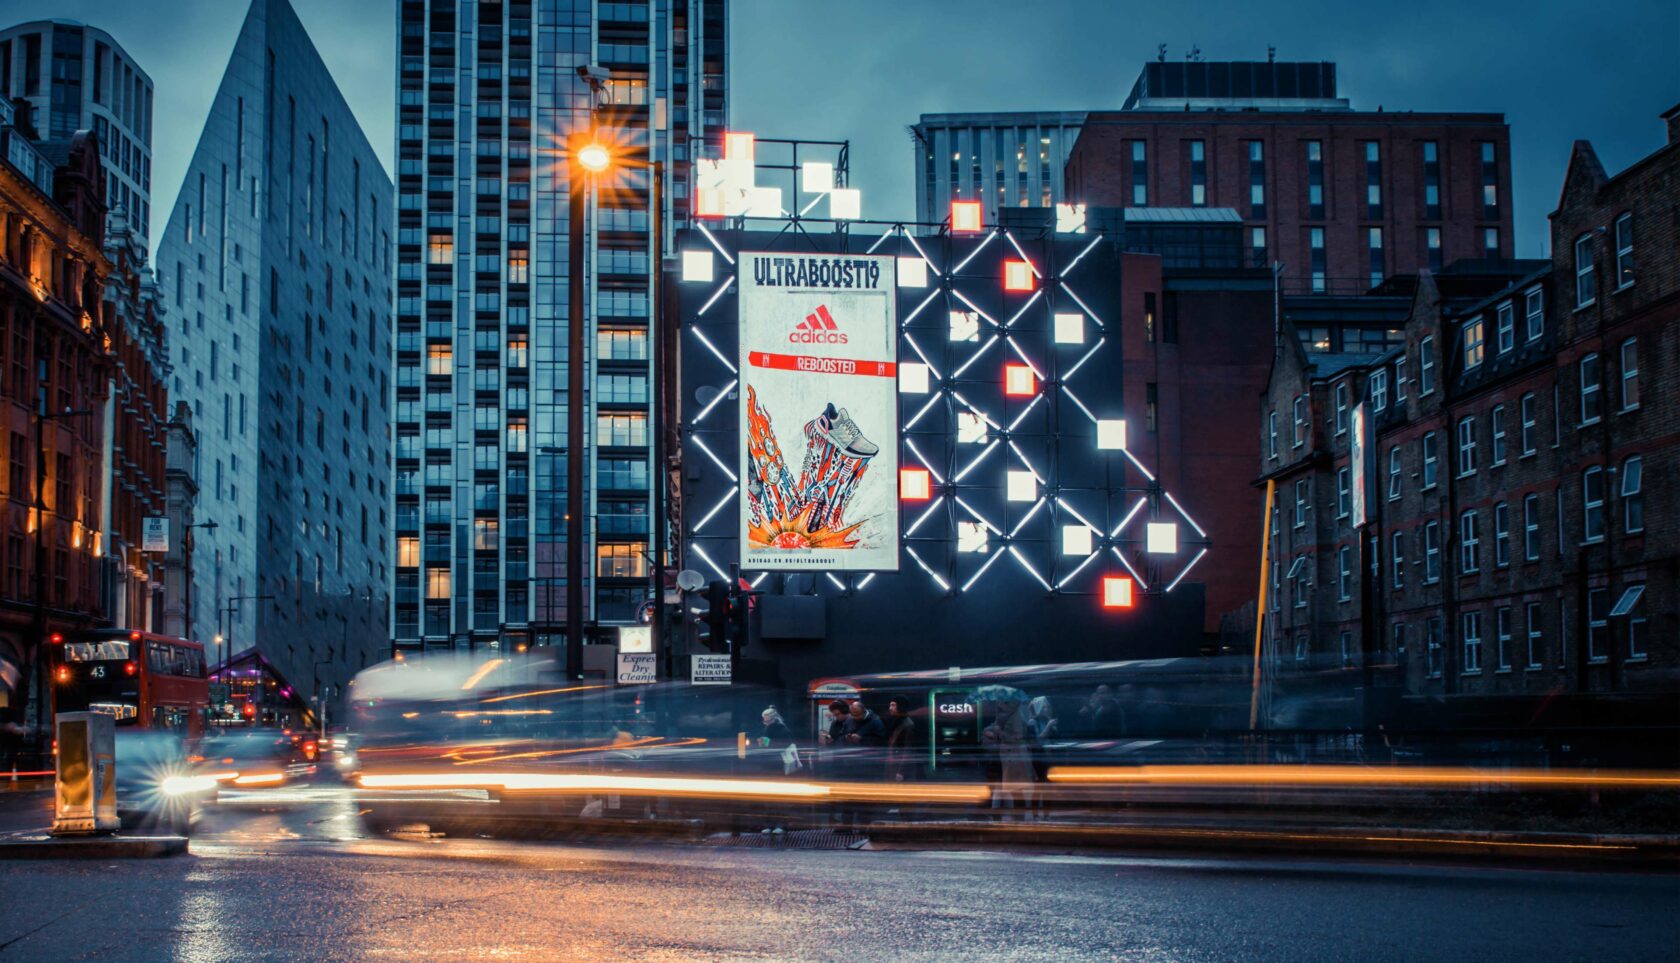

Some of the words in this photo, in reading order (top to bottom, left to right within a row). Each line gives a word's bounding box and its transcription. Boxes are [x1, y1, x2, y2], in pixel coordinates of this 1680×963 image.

[754, 257, 880, 288] ULTRABOOST19
[789, 330, 848, 344] adidas
[797, 357, 856, 373] REBOOSTED
[623, 655, 656, 664] Expres
[90, 666, 105, 678] 43
[632, 664, 650, 674] Dry
[619, 672, 656, 681] Cleanin
[940, 701, 973, 714] cash
